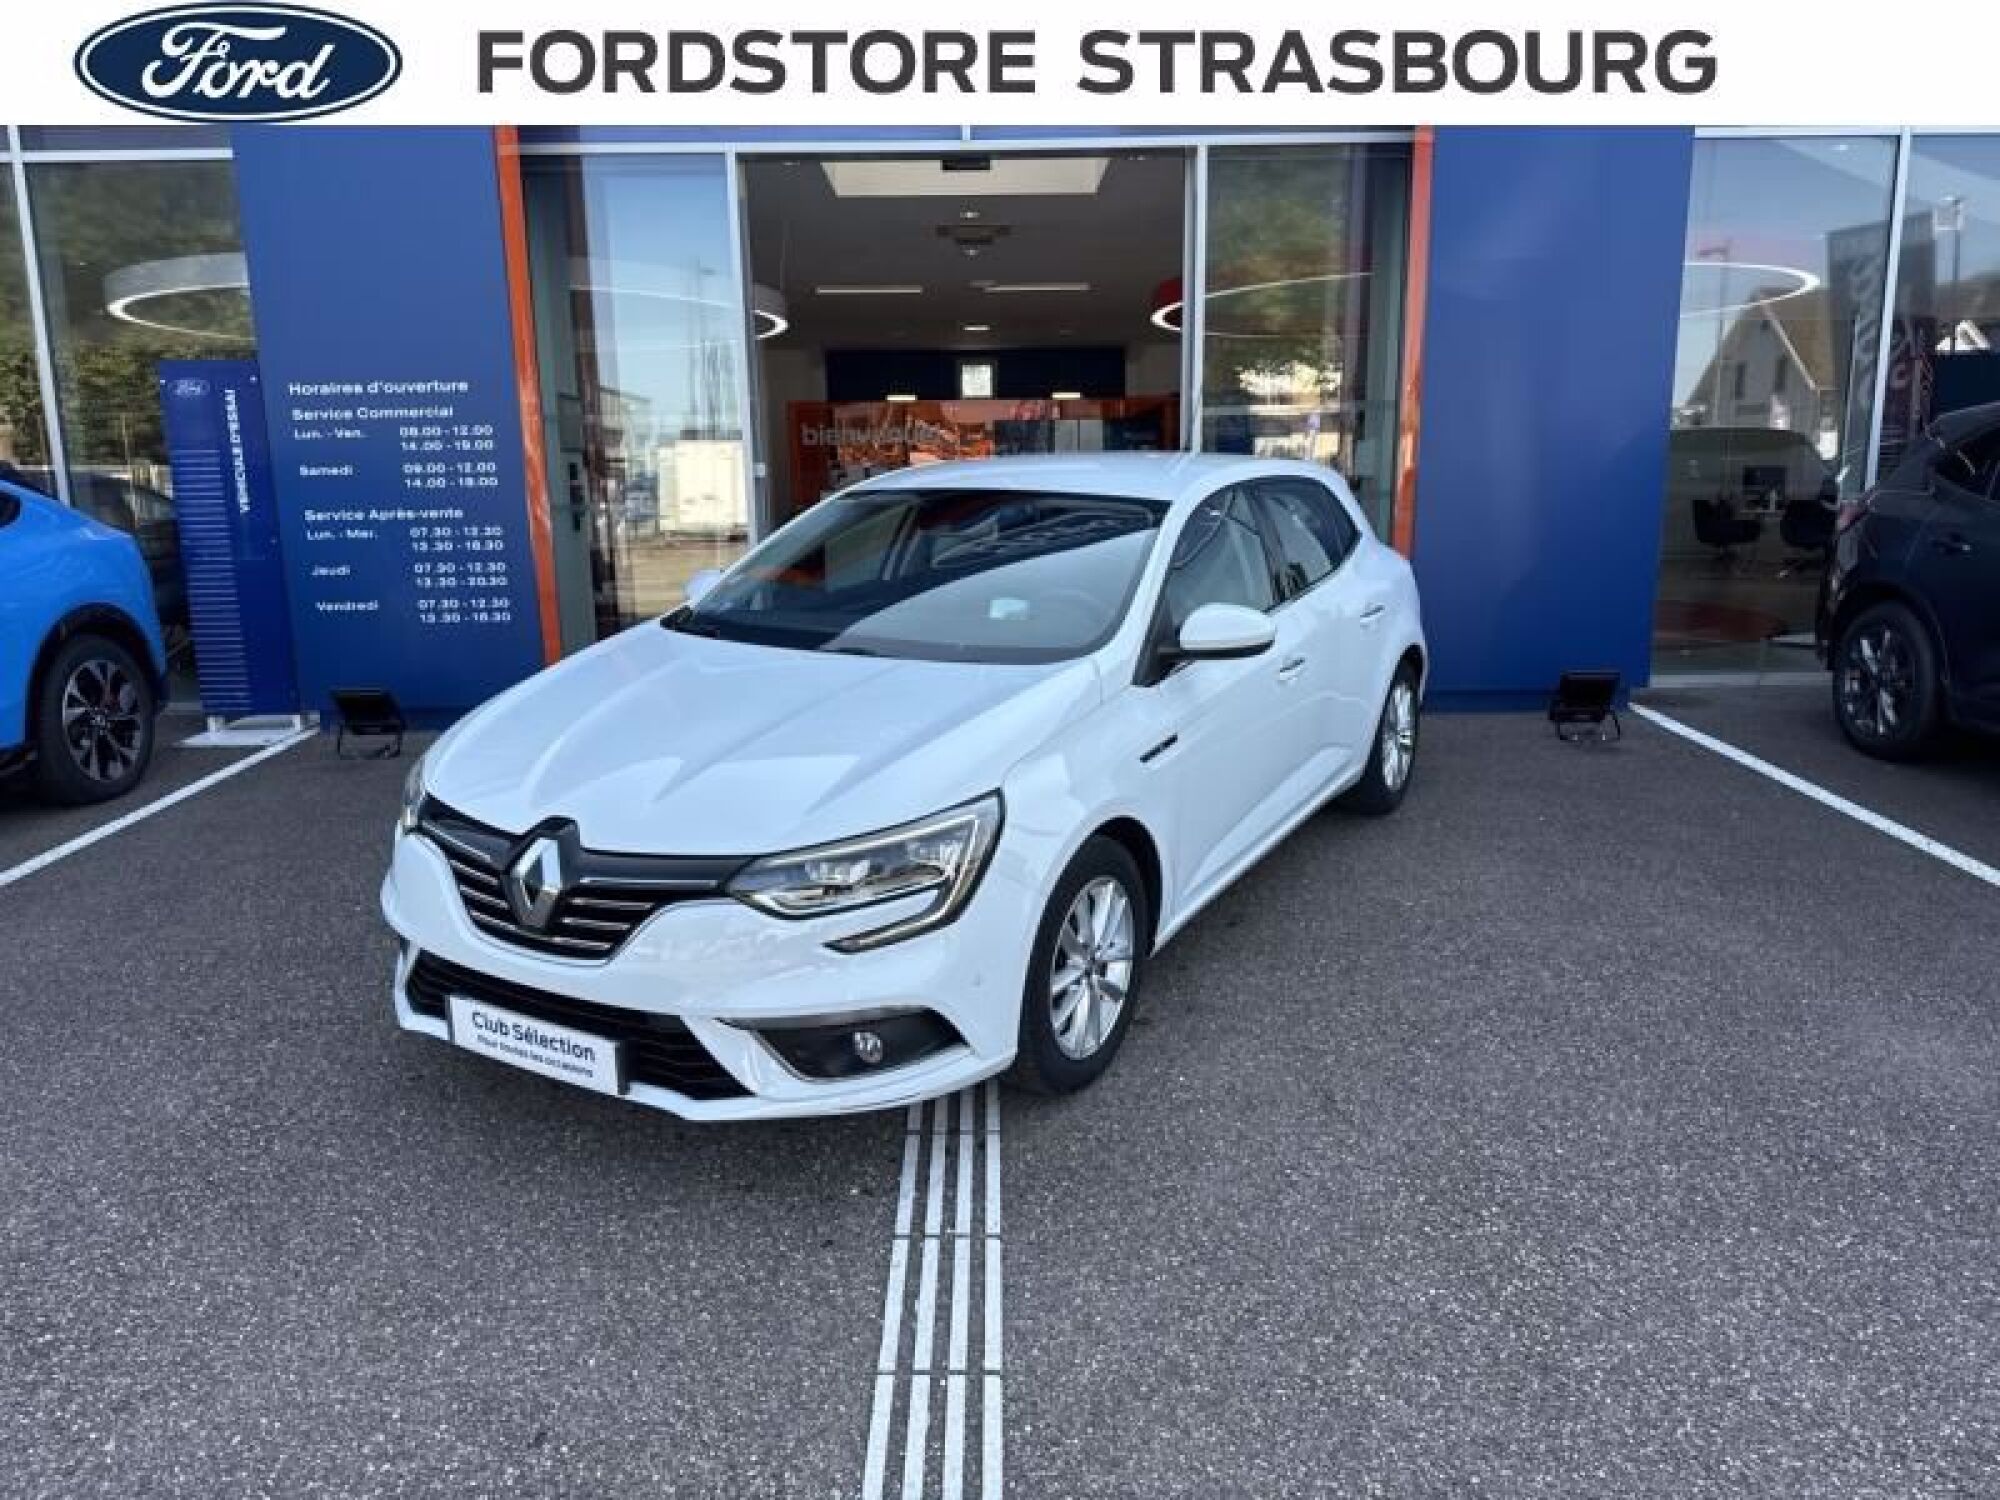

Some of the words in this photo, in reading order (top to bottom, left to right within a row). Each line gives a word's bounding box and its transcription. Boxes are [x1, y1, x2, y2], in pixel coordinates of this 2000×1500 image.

[289, 381, 363, 396] Horaires
[367, 379, 468, 395] d'ouverture
[292, 407, 353, 421] Service
[357, 404, 453, 419] Commercial
[299, 464, 353, 476] Samedi
[304, 508, 364, 521] Service
[311, 564, 351, 576] Jeudi
[315, 600, 378, 612] Vendredi
[471, 1011, 511, 1036] Club
[512, 1023, 596, 1063] Sélection
